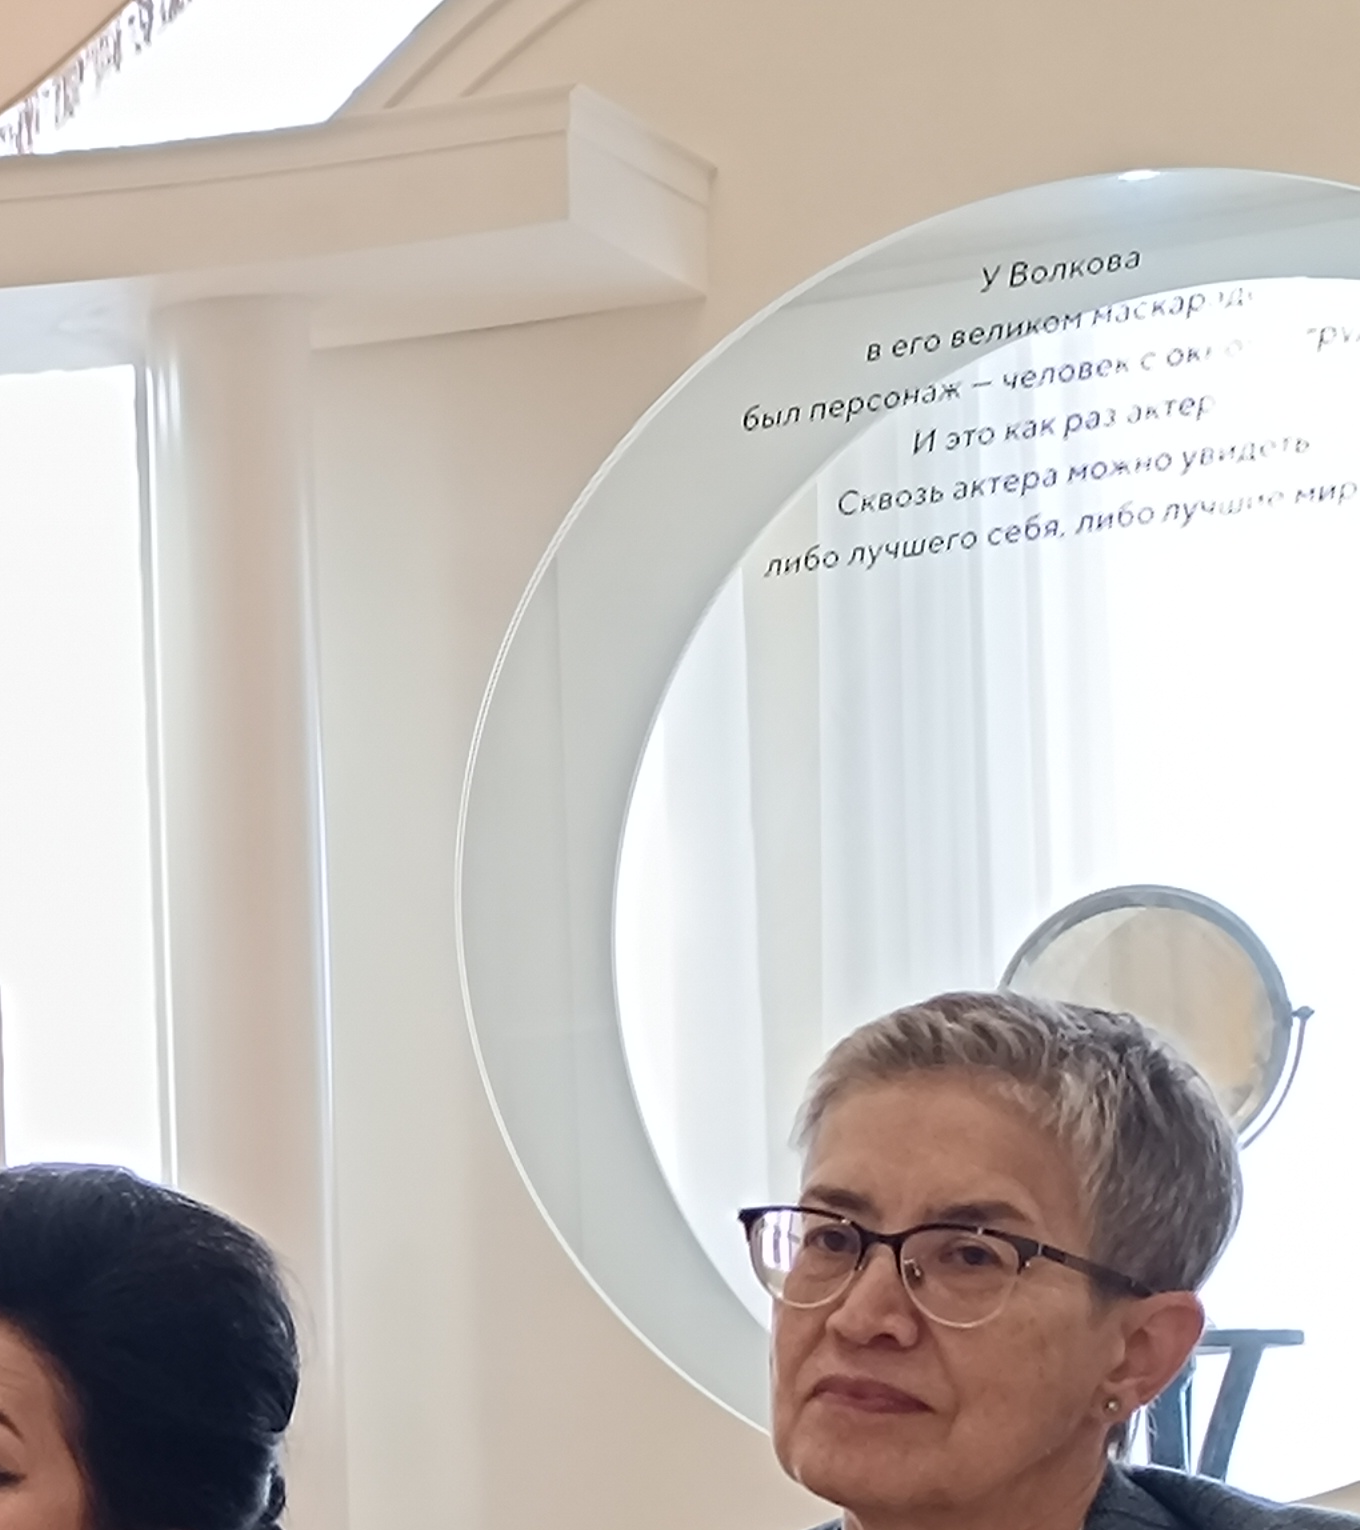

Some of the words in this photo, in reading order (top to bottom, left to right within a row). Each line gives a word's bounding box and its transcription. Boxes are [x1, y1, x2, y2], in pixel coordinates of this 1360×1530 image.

[980, 266, 1001, 294] У
[1009, 249, 1142, 290] Волкова
[866, 341, 881, 363] в
[891, 331, 941, 361] его
[951, 311, 1082, 348] великом
[743, 405, 801, 432] был
[810, 380, 962, 425] персонаж
[1002, 355, 1129, 391] человек
[1141, 351, 1156, 371] с
[912, 428, 936, 456] И
[945, 425, 995, 452] это
[1004, 415, 1055, 442] как
[1063, 406, 1117, 440] раз
[1127, 394, 1216, 425] актер
[837, 482, 944, 516] Сквозь
[952, 466, 1058, 500] актера
[1066, 451, 1173, 485] можно
[1181, 437, 1309, 476] увидеть
[764, 547, 840, 579] либо
[846, 527, 978, 569] лучшего
[986, 515, 1065, 546] себя,
[1075, 501, 1154, 535] либо
